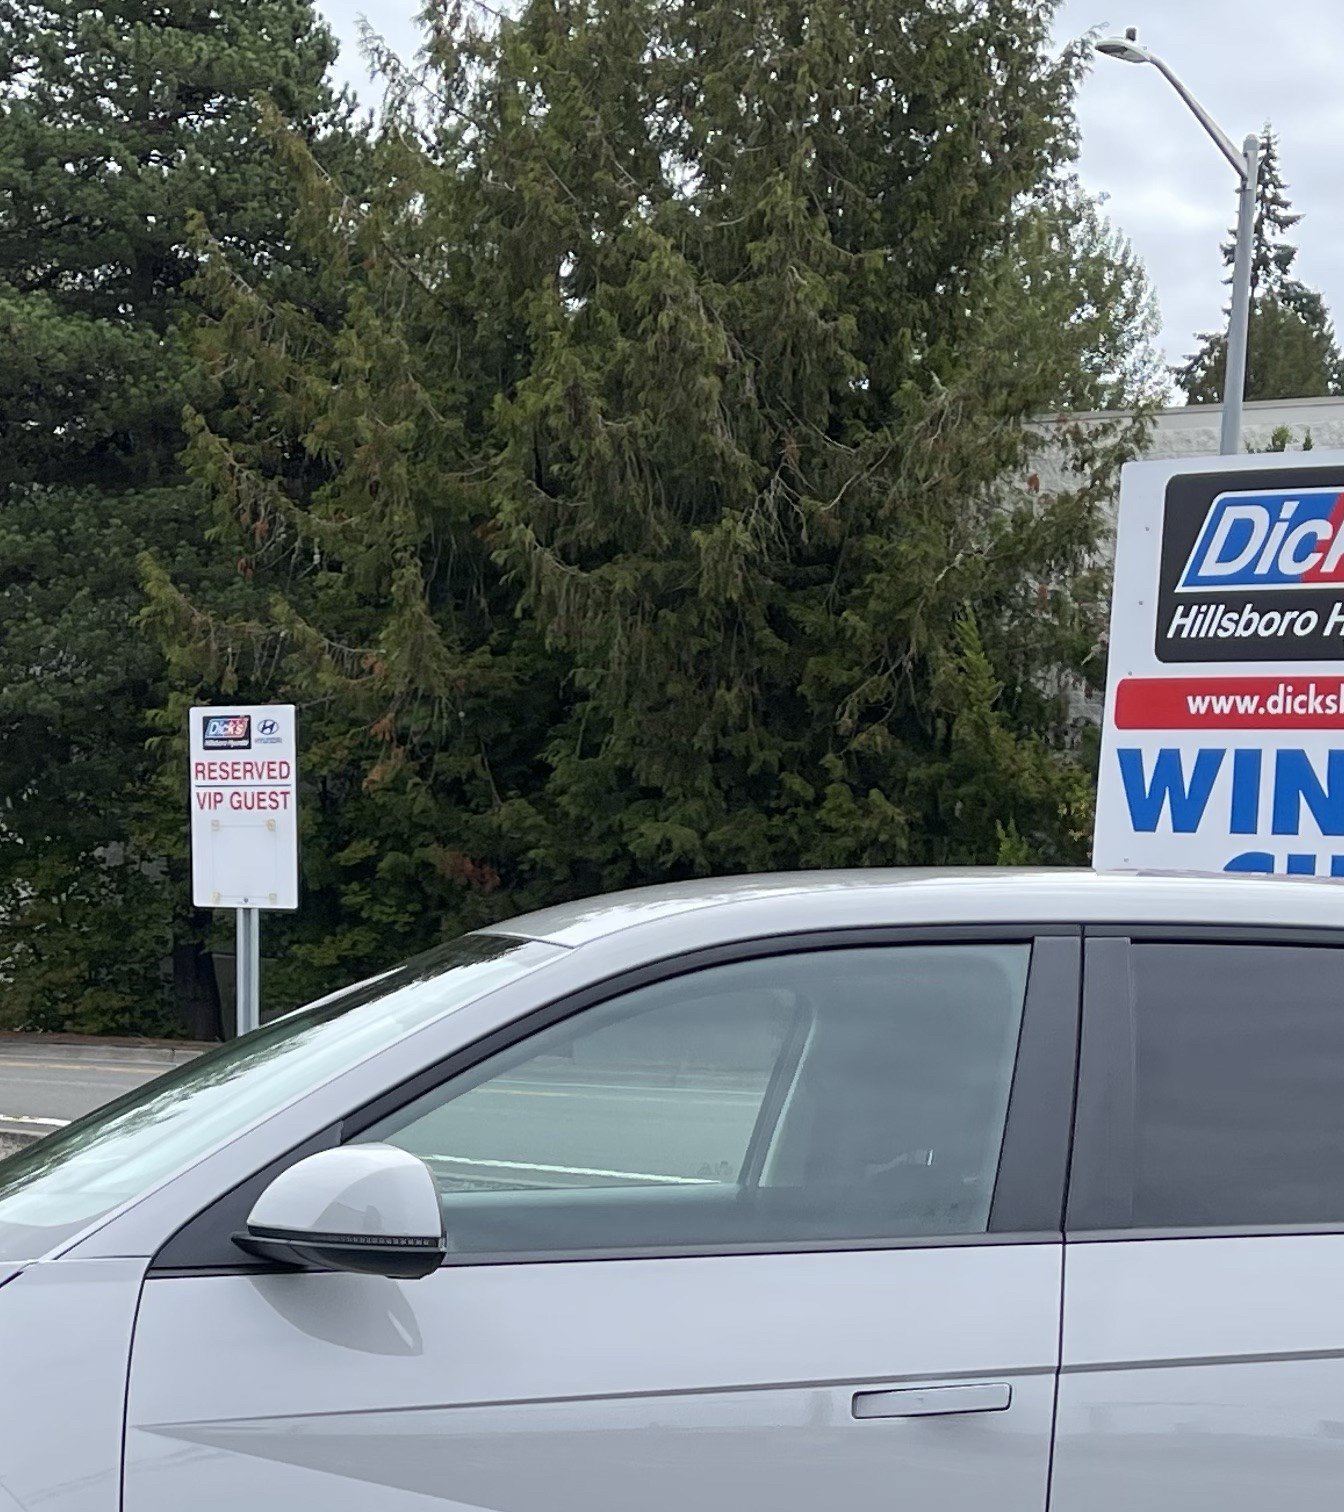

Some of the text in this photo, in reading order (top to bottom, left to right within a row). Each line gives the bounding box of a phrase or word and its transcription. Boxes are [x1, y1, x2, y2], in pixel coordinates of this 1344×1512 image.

[1166, 603, 1319, 639] Hillsboro
[195, 760, 291, 781] RESERVED
[196, 790, 291, 811] VIP GUEST
